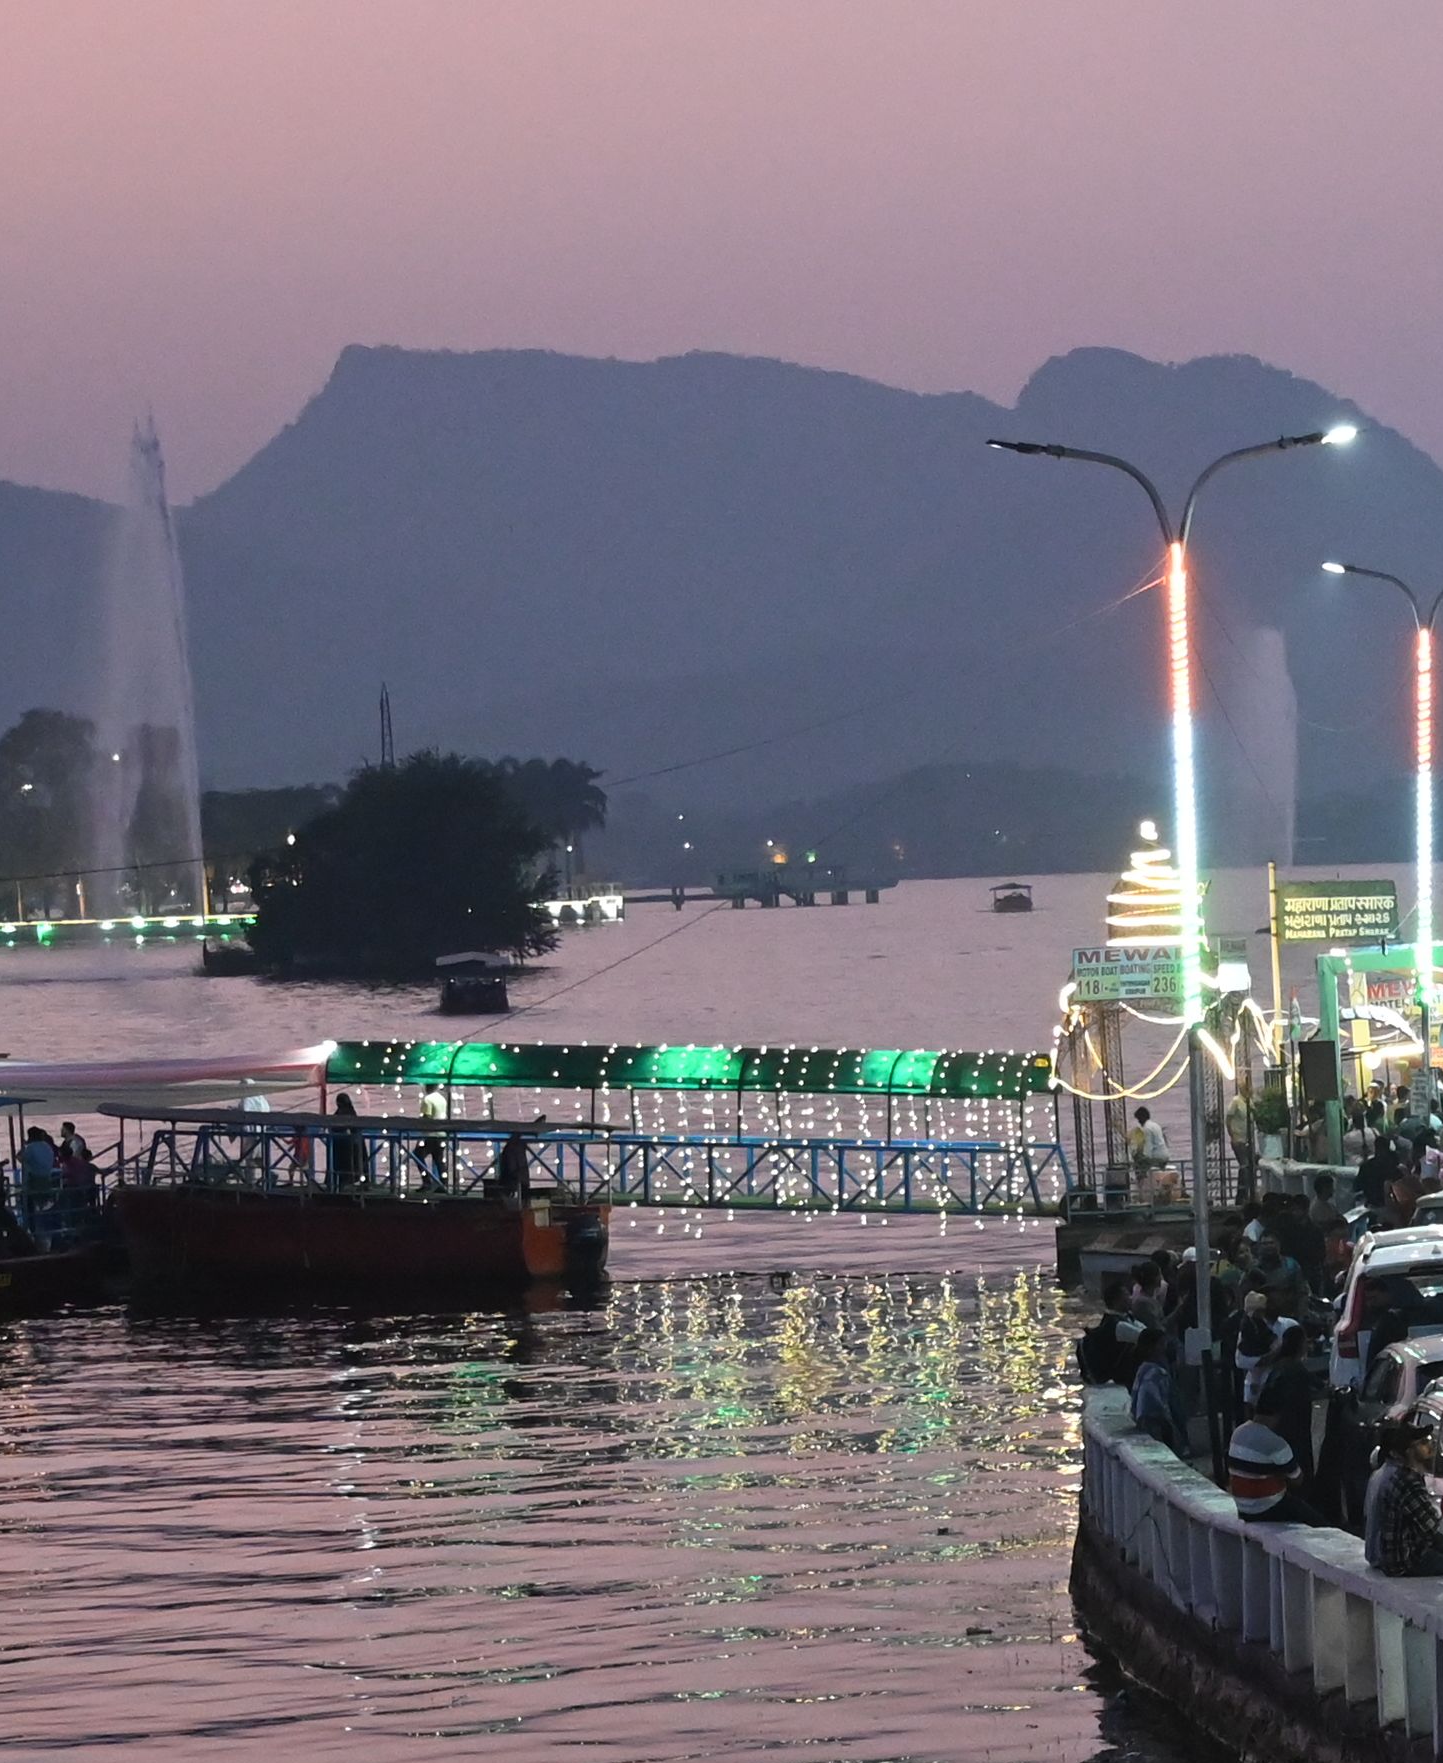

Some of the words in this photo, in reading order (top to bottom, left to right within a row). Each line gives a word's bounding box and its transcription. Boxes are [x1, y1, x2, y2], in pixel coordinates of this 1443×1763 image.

[1284, 897, 1329, 914] महाराणा
[1329, 896, 1356, 911] प्रताप
[1077, 947, 1183, 964] MEWA
